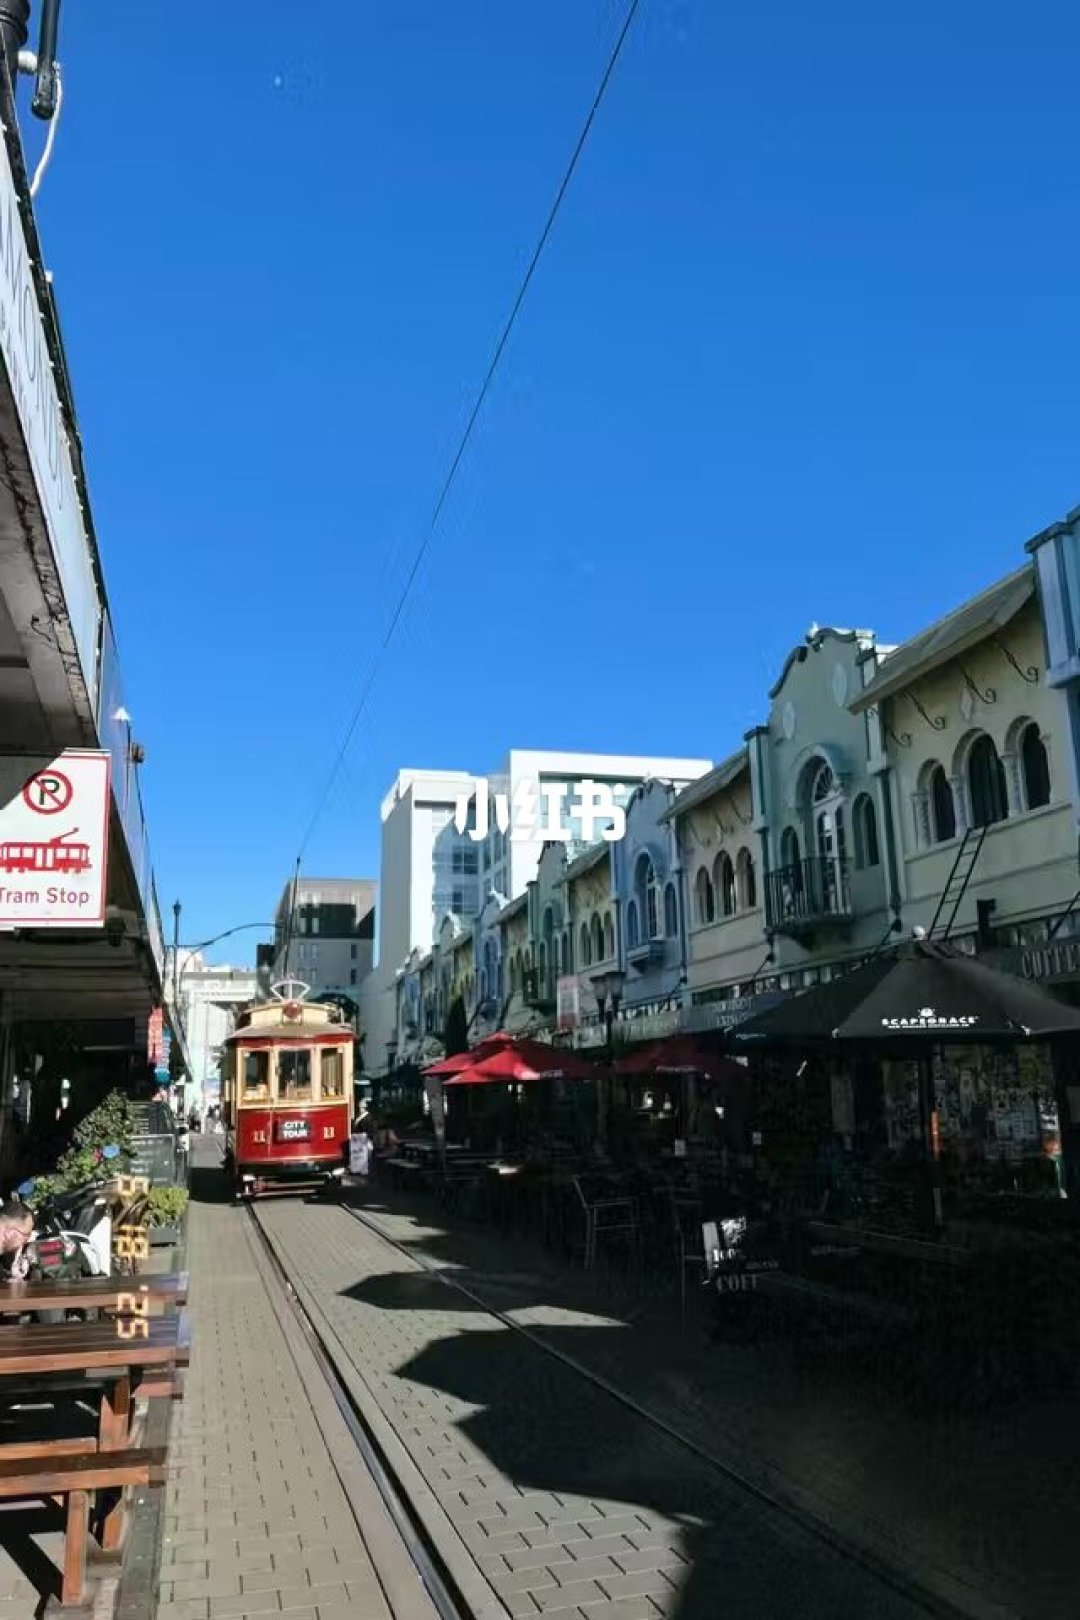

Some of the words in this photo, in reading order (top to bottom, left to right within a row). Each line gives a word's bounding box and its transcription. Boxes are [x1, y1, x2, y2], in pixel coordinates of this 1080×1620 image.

[0, 887, 39, 904] Tram
[46, 887, 89, 908] Stop
[284, 1120, 305, 1130] CITY
[283, 1129, 308, 1139] TOUR
